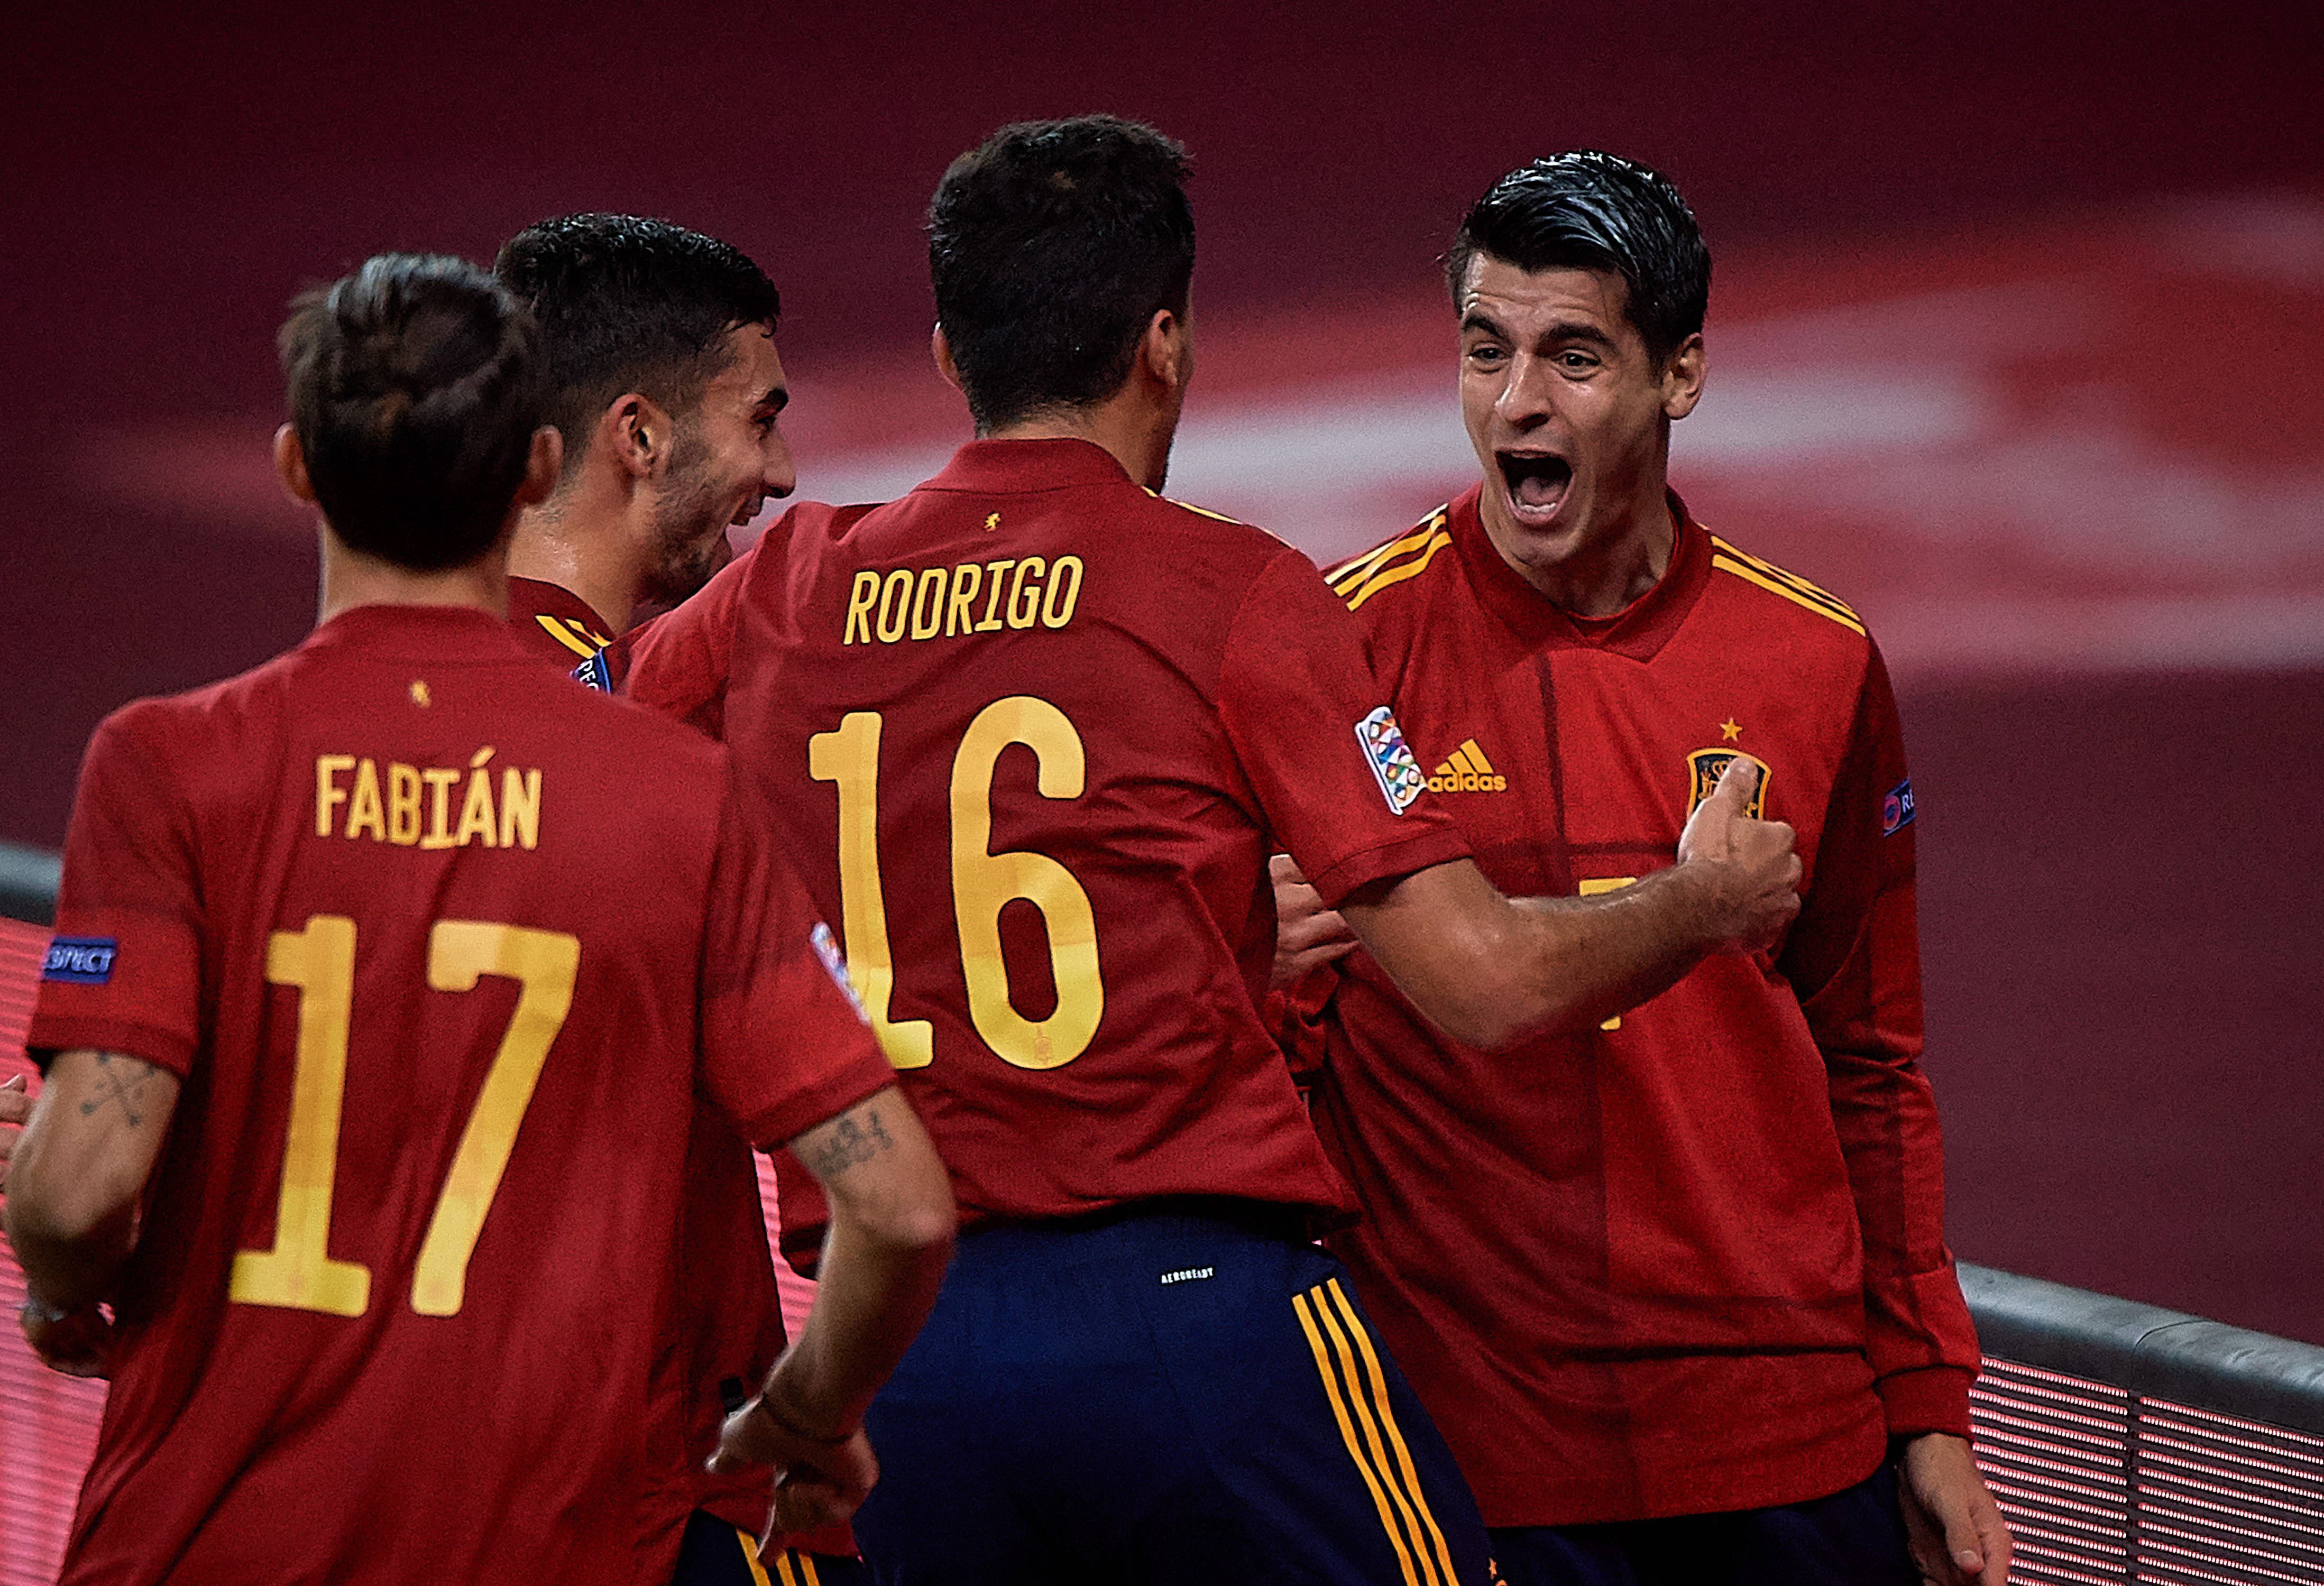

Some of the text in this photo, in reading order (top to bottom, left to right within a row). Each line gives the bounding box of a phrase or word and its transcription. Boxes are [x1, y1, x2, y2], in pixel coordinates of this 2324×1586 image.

[843, 555, 1084, 644] RODRIGO
[317, 747, 542, 849] FABIÁN
[1428, 771, 1507, 792] adidas
[809, 696, 1104, 1069] 16
[229, 915, 581, 1316] 17
